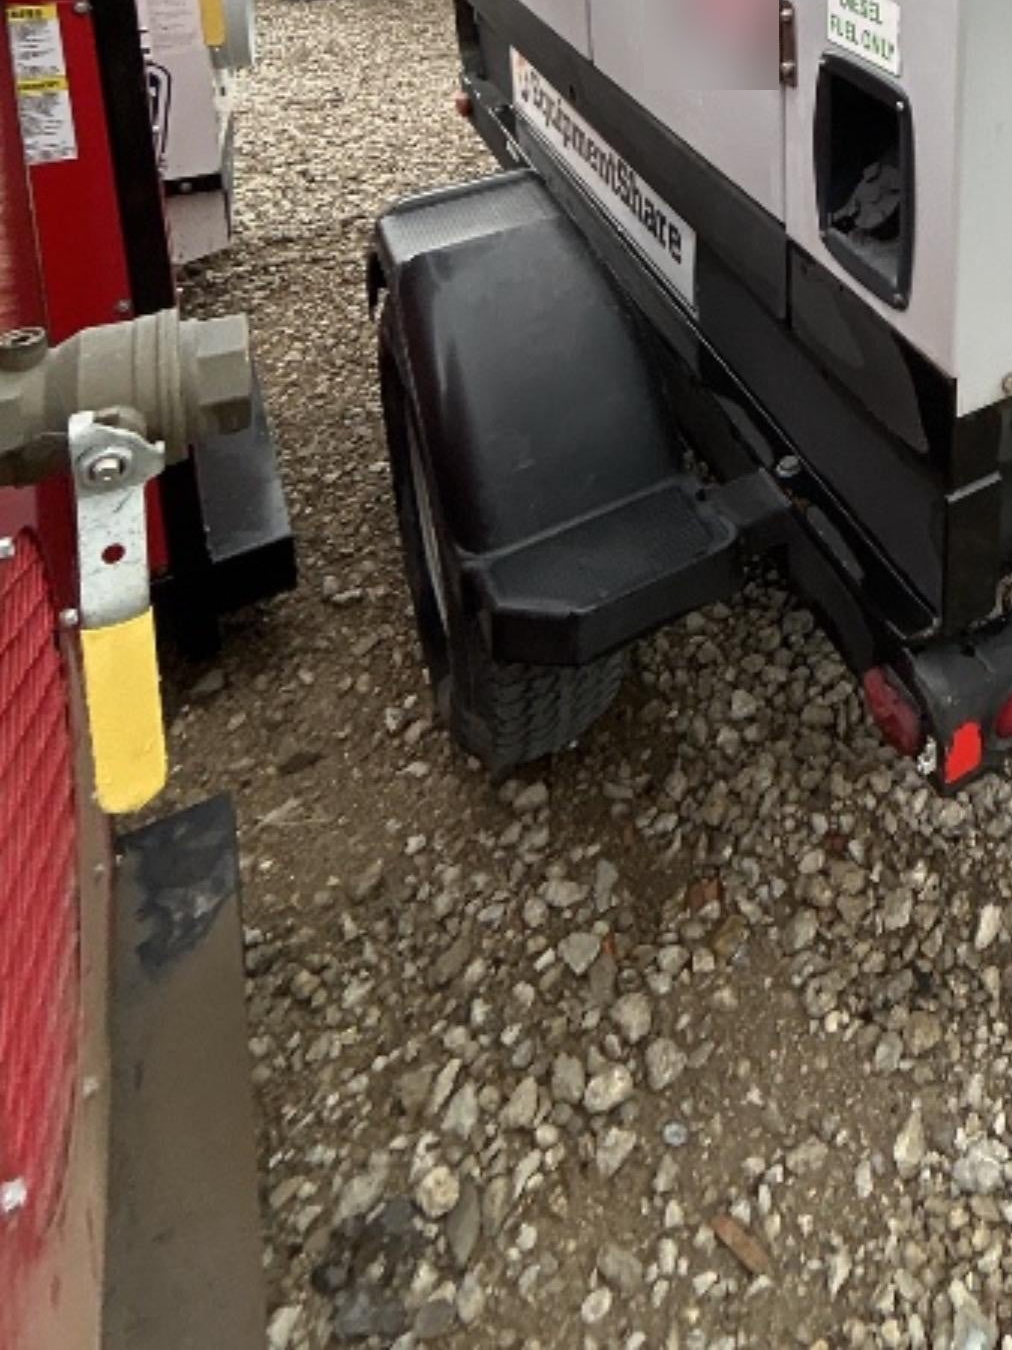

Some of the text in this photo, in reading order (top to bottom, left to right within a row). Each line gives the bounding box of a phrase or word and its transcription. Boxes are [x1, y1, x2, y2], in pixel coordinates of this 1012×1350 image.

[831, 14, 895, 59] FUEL ONLY
[530, 68, 682, 264] EquipmentShare
